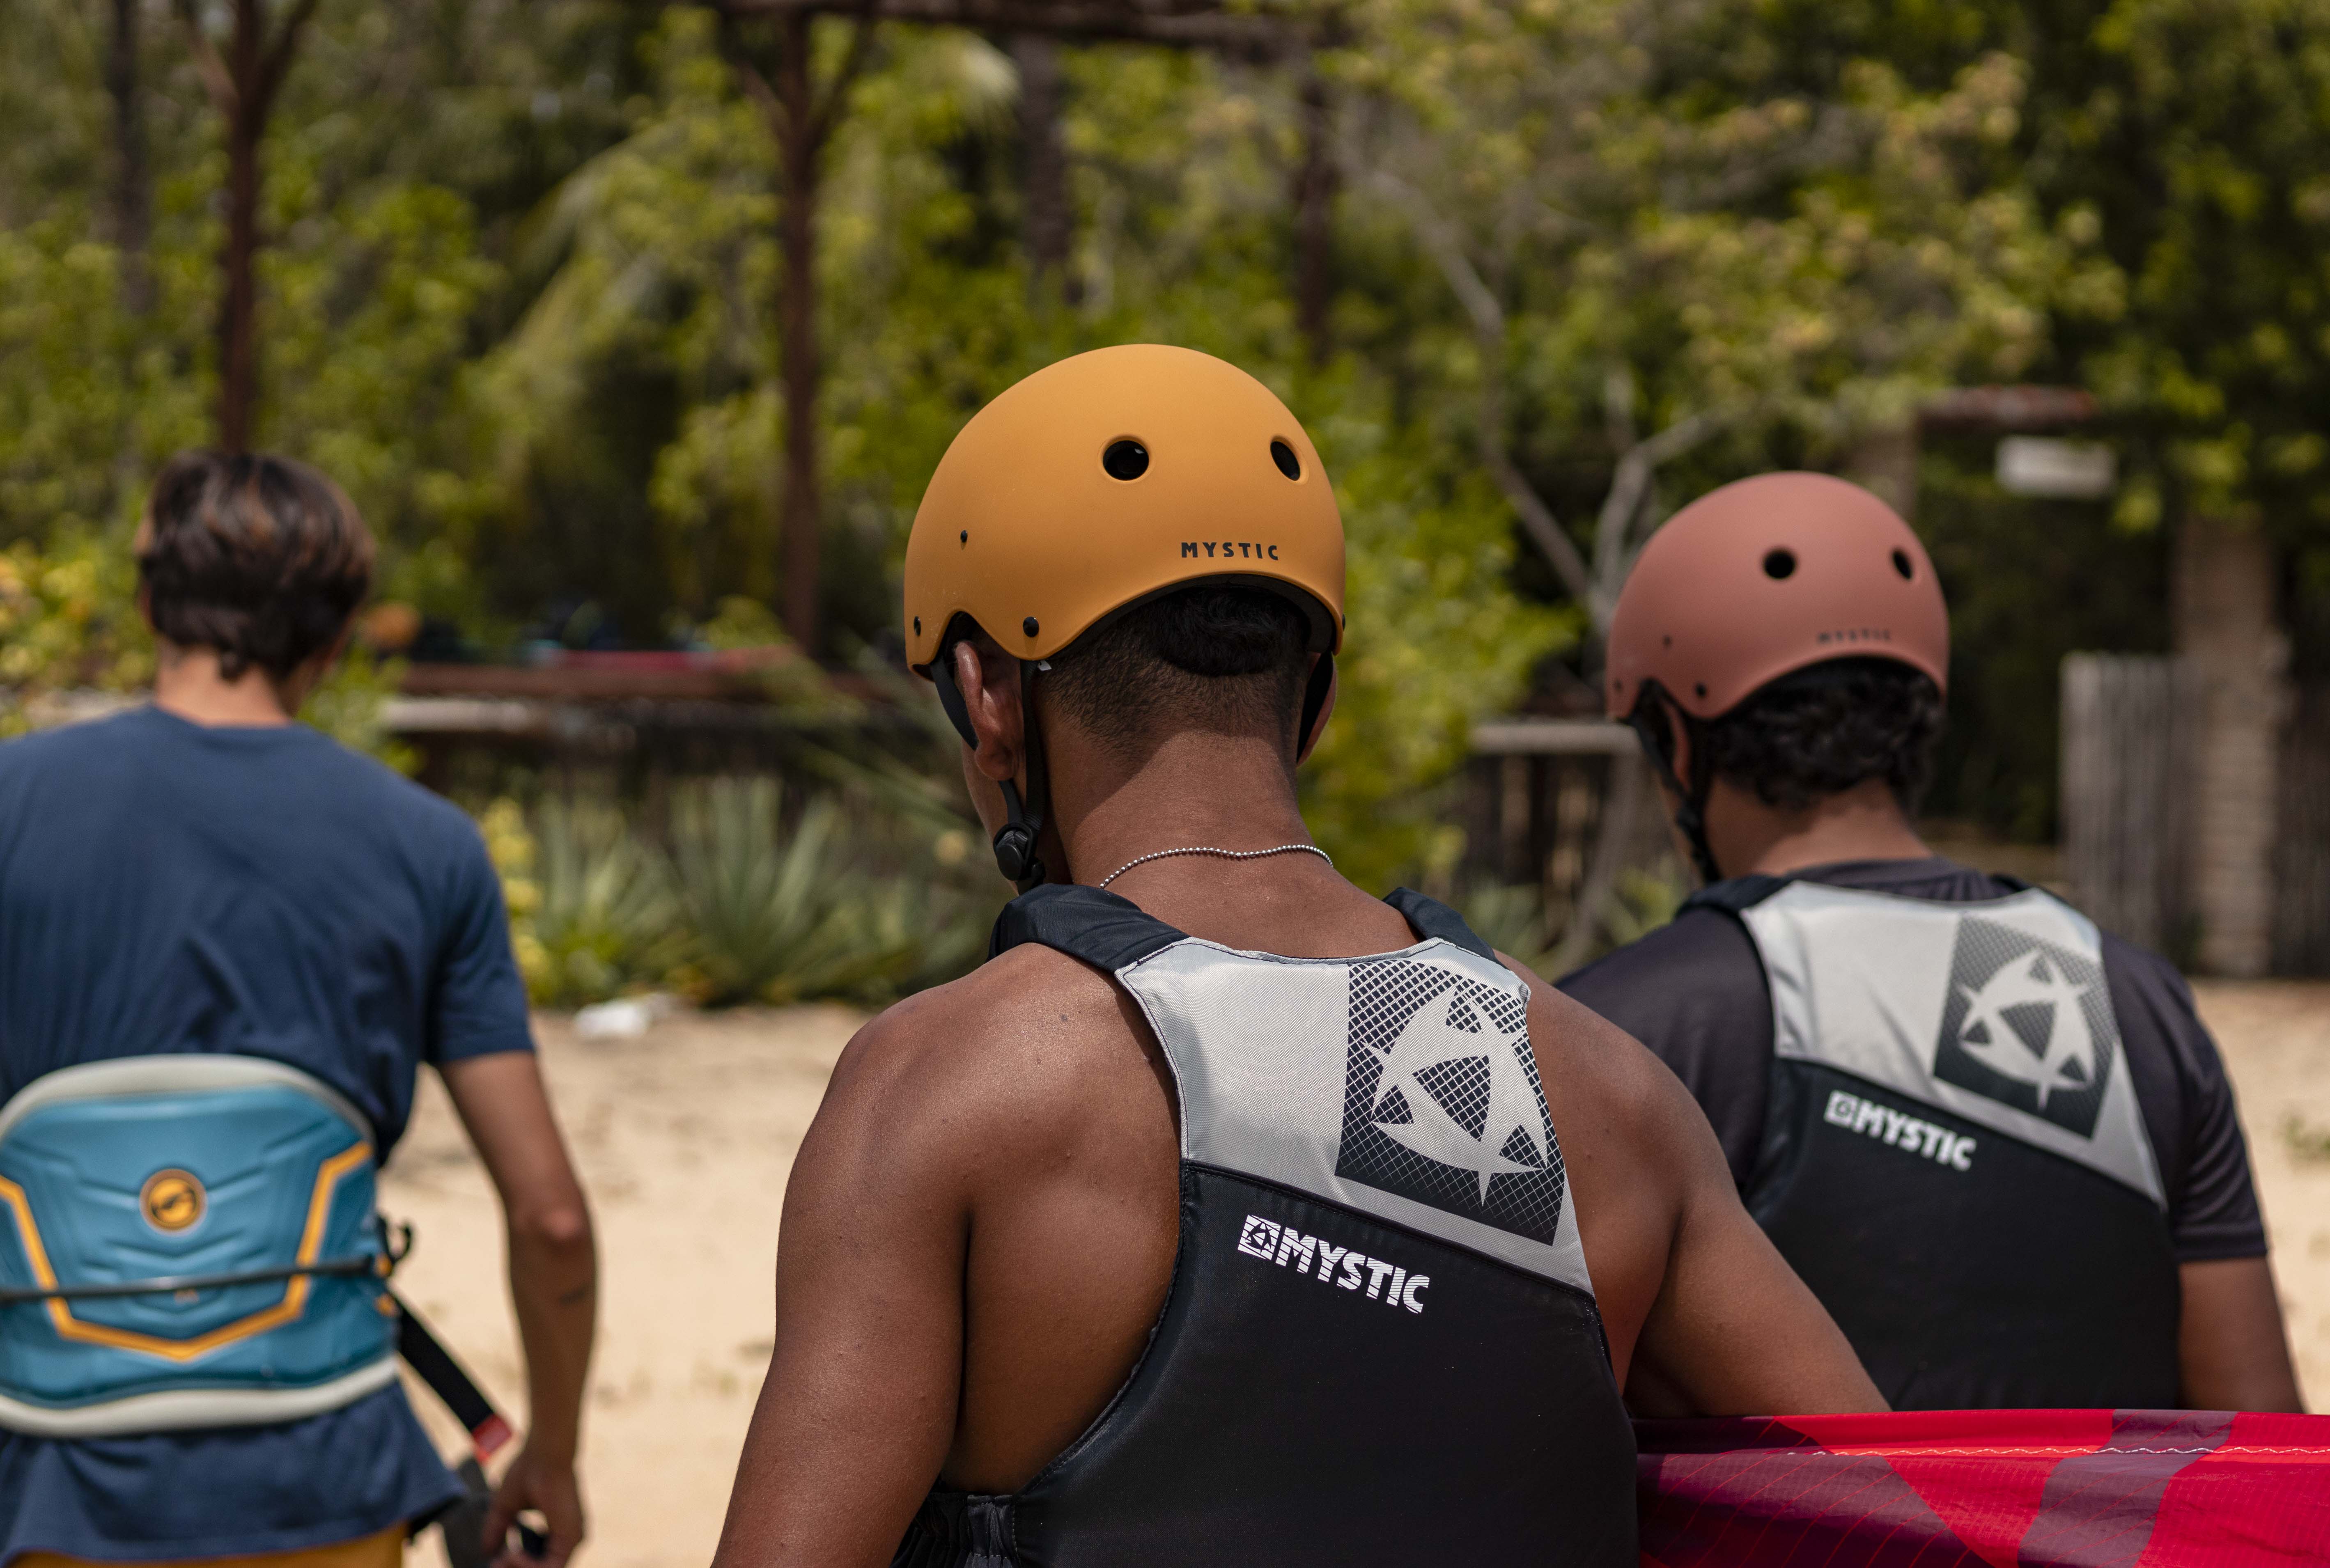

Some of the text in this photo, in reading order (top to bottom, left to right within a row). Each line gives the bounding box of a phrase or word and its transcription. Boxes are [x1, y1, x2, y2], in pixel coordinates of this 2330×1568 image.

[1181, 542, 1279, 561] MYSTIC
[1852, 1098, 1977, 1171] MYSTIC
[1275, 1226, 1430, 1314] MYSTIC
